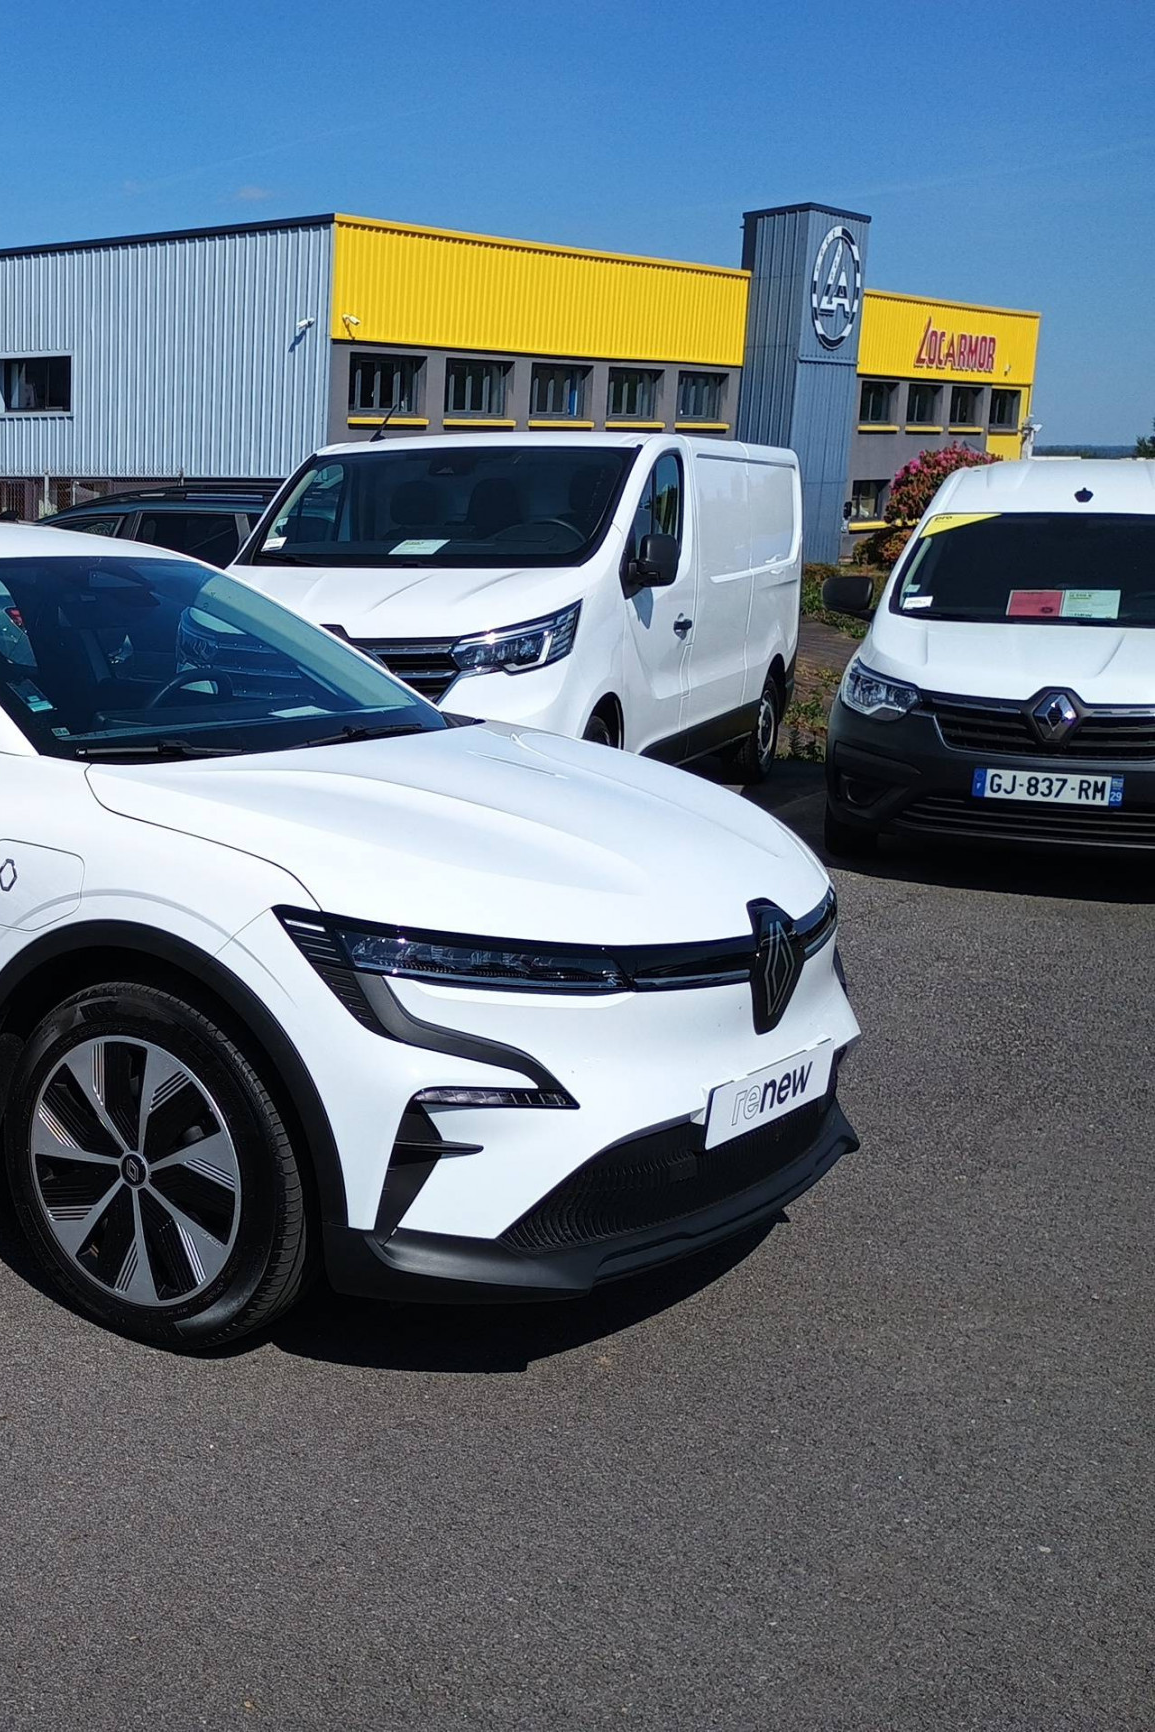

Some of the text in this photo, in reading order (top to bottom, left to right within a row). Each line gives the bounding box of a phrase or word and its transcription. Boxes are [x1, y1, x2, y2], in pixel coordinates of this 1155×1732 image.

[913, 315, 996, 371] LOCARMOR
[1110, 791, 1122, 802] 29
[731, 1061, 813, 1126] renew
